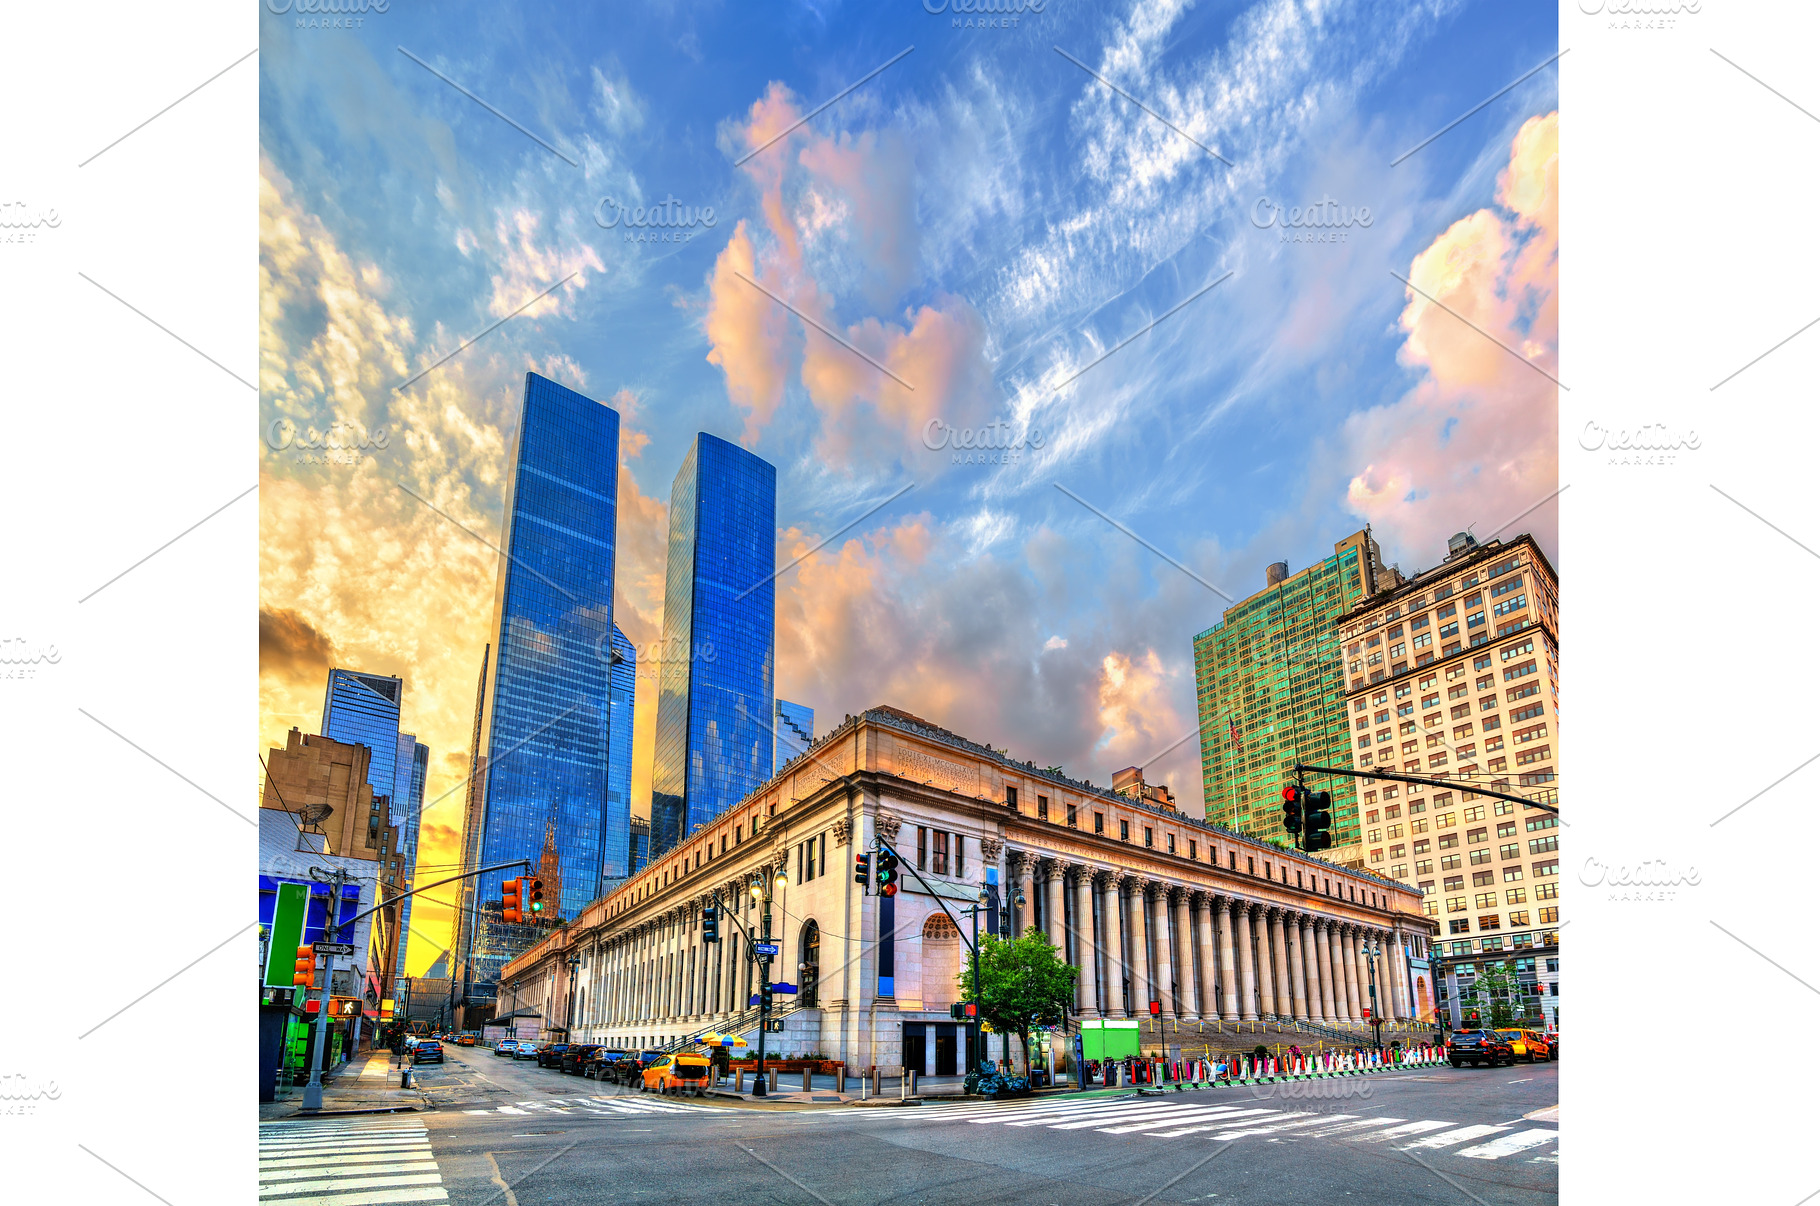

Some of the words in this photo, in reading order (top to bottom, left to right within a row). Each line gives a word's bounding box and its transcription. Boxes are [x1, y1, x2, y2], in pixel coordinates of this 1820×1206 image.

[898, 747, 921, 760] LOUIS
[1008, 831, 1047, 846] NEITHER
[1053, 842, 1075, 853] SNOW
